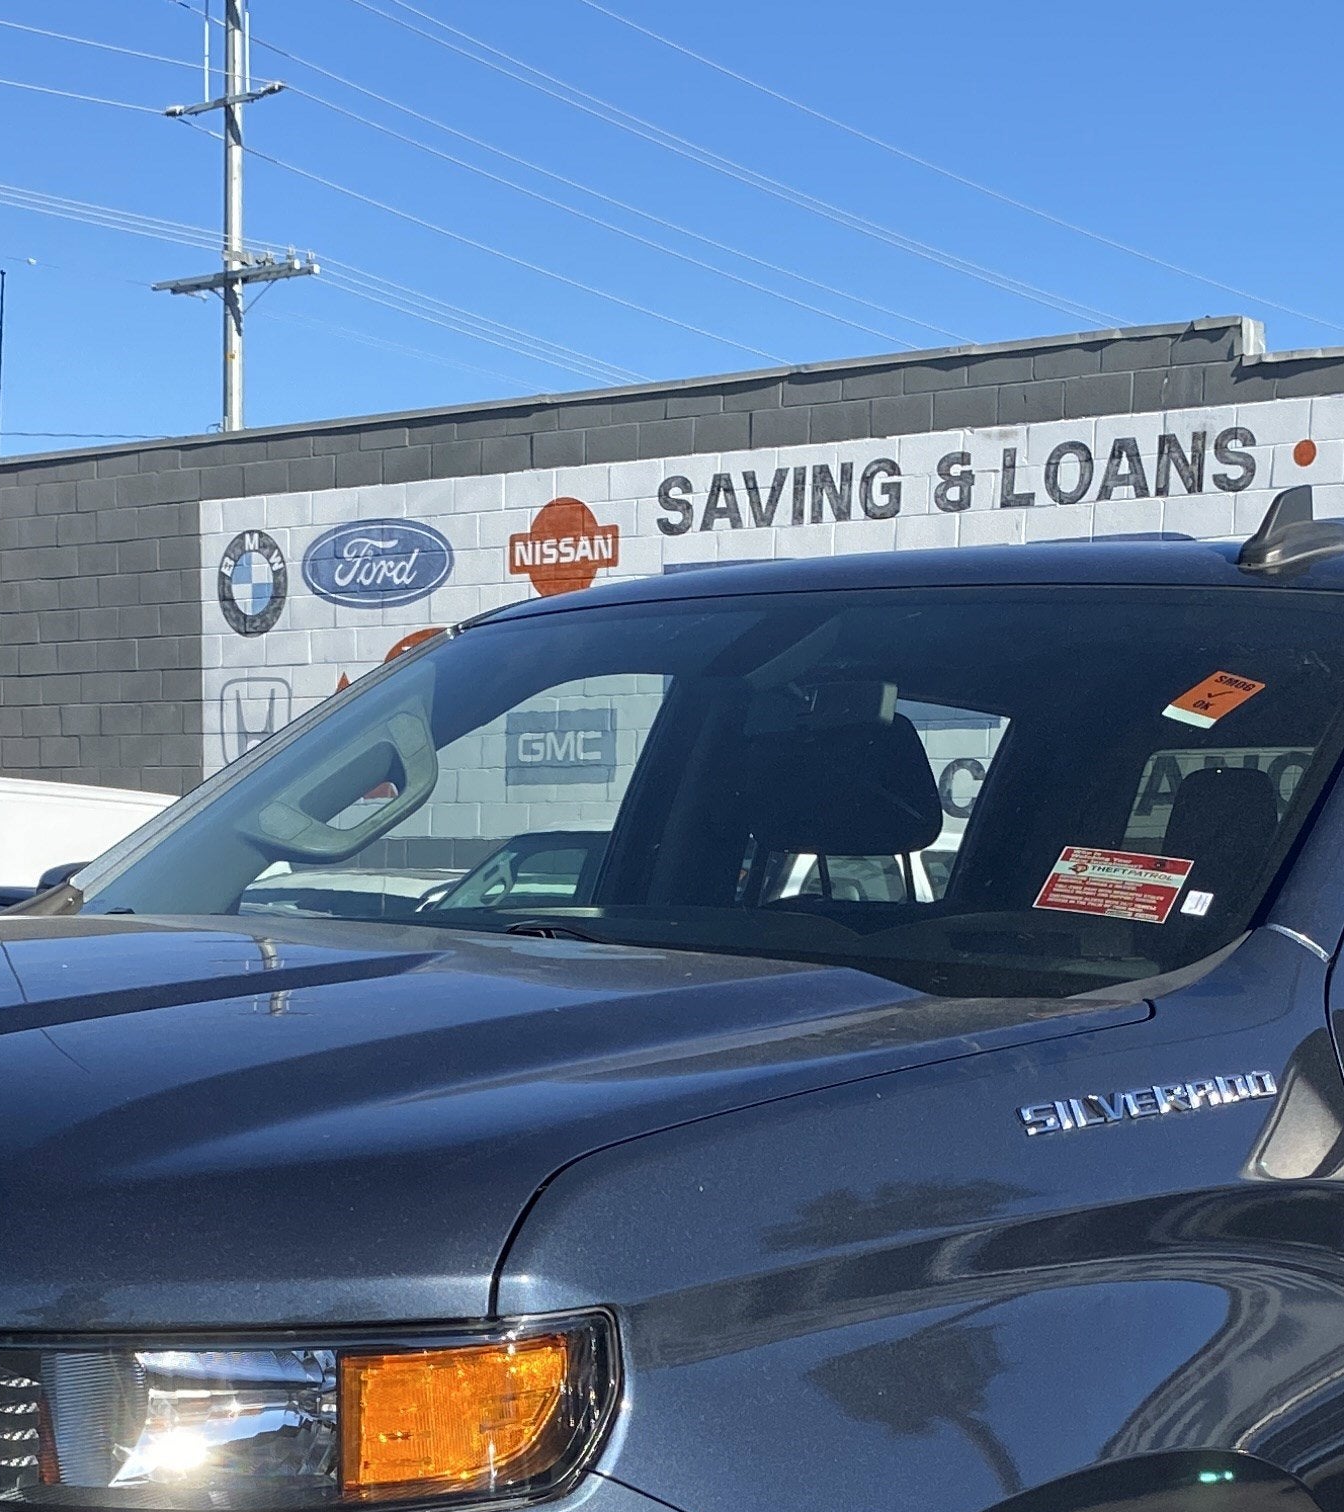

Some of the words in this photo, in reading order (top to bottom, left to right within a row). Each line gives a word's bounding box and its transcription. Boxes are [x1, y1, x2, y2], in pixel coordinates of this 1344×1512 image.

[657, 457, 902, 536] SAVING
[934, 451, 974, 513] &
[1000, 426, 1257, 508] LOANS
[220, 531, 285, 577] BMW
[334, 537, 419, 588] Ford
[514, 534, 615, 568] NISSAN
[1215, 674, 1256, 692] SMOG
[1192, 699, 1216, 712] OK
[518, 731, 602, 763] GMC
[1017, 1069, 1278, 1137] SILVERADO
